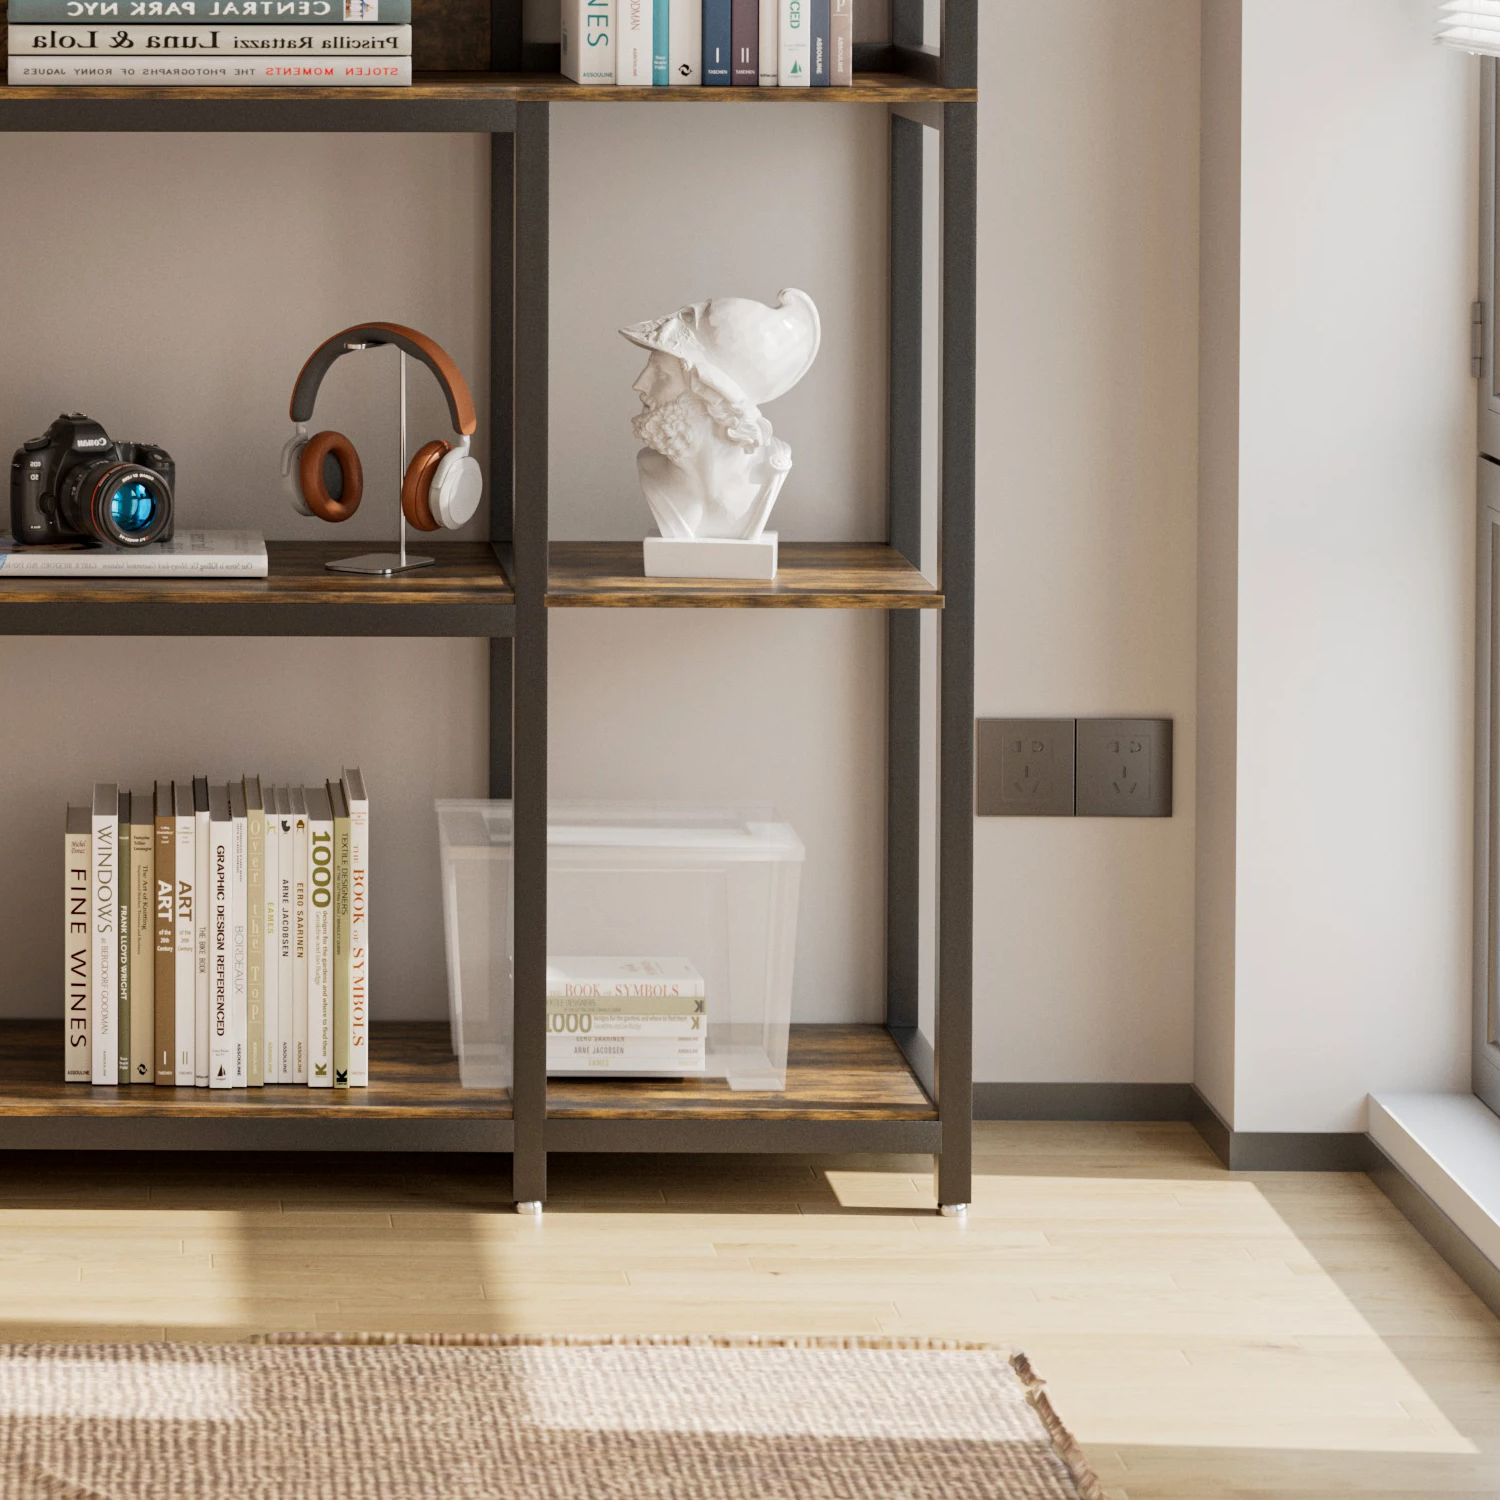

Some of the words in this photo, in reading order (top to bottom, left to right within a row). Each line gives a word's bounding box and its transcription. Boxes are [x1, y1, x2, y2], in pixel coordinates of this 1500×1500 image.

[217, 845, 225, 901] GRAPHIC
[312, 830, 332, 908] 1000
[341, 833, 349, 865] TEXTILE
[71, 869, 87, 934] FINE
[97, 825, 112, 933] WINDOWS
[158, 880, 173, 922] ART
[178, 880, 192, 922] ART
[341, 868, 349, 916] DESIGNERS
[353, 869, 365, 924] BOOK
[120, 905, 128, 933] FRANK
[217, 905, 225, 950] DESIGN
[267, 902, 275, 934] EAMES
[120, 935, 128, 963] LLOYD
[235, 925, 244, 994] BORDEAUX
[70, 949, 87, 1047] WINES
[120, 965, 128, 1000] WRIGHT
[216, 955, 225, 1036] REFERENCED
[352, 947, 364, 1047] SYMBOLS
[565, 983, 600, 997] BOOK
[615, 983, 680, 998] SYMBOLS
